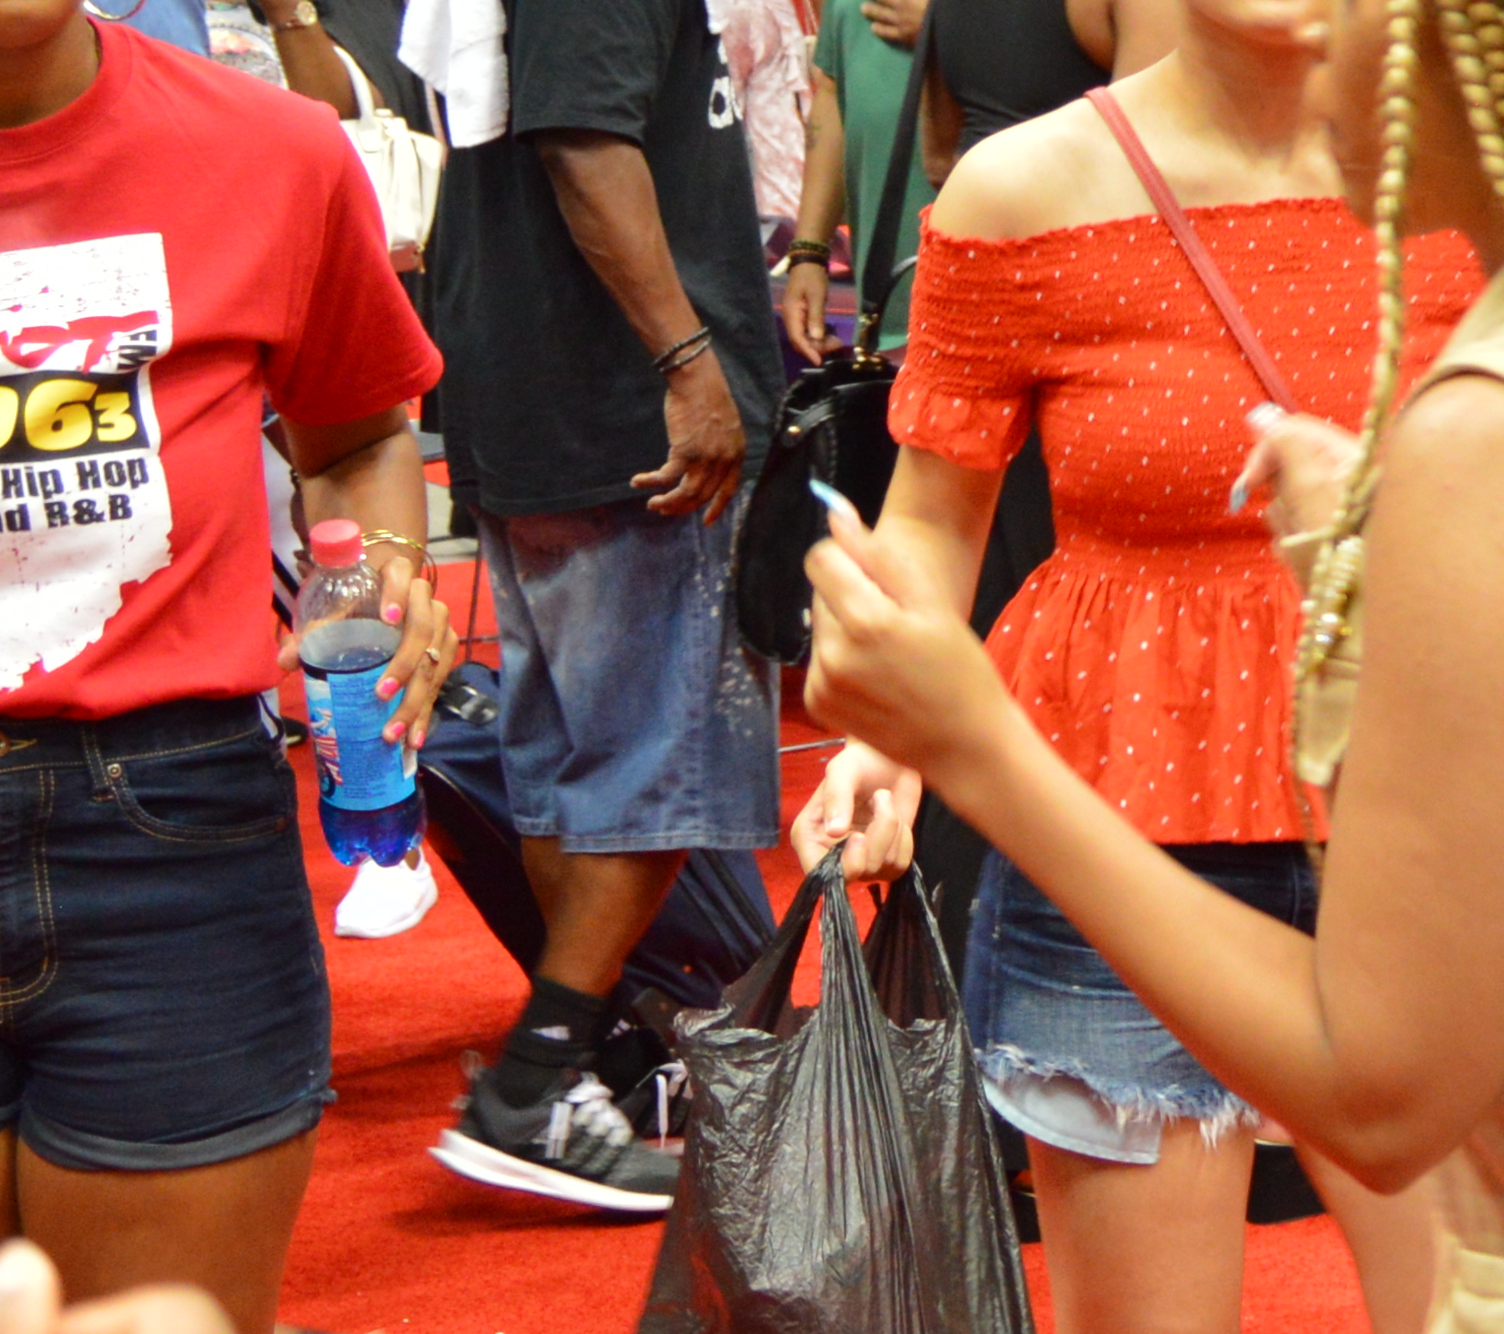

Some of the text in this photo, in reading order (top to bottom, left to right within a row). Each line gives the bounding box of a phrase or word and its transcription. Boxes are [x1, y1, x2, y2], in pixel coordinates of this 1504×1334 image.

[0, 466, 65, 500] Hip
[75, 456, 150, 491] Hop
[43, 493, 134, 529] R&B
